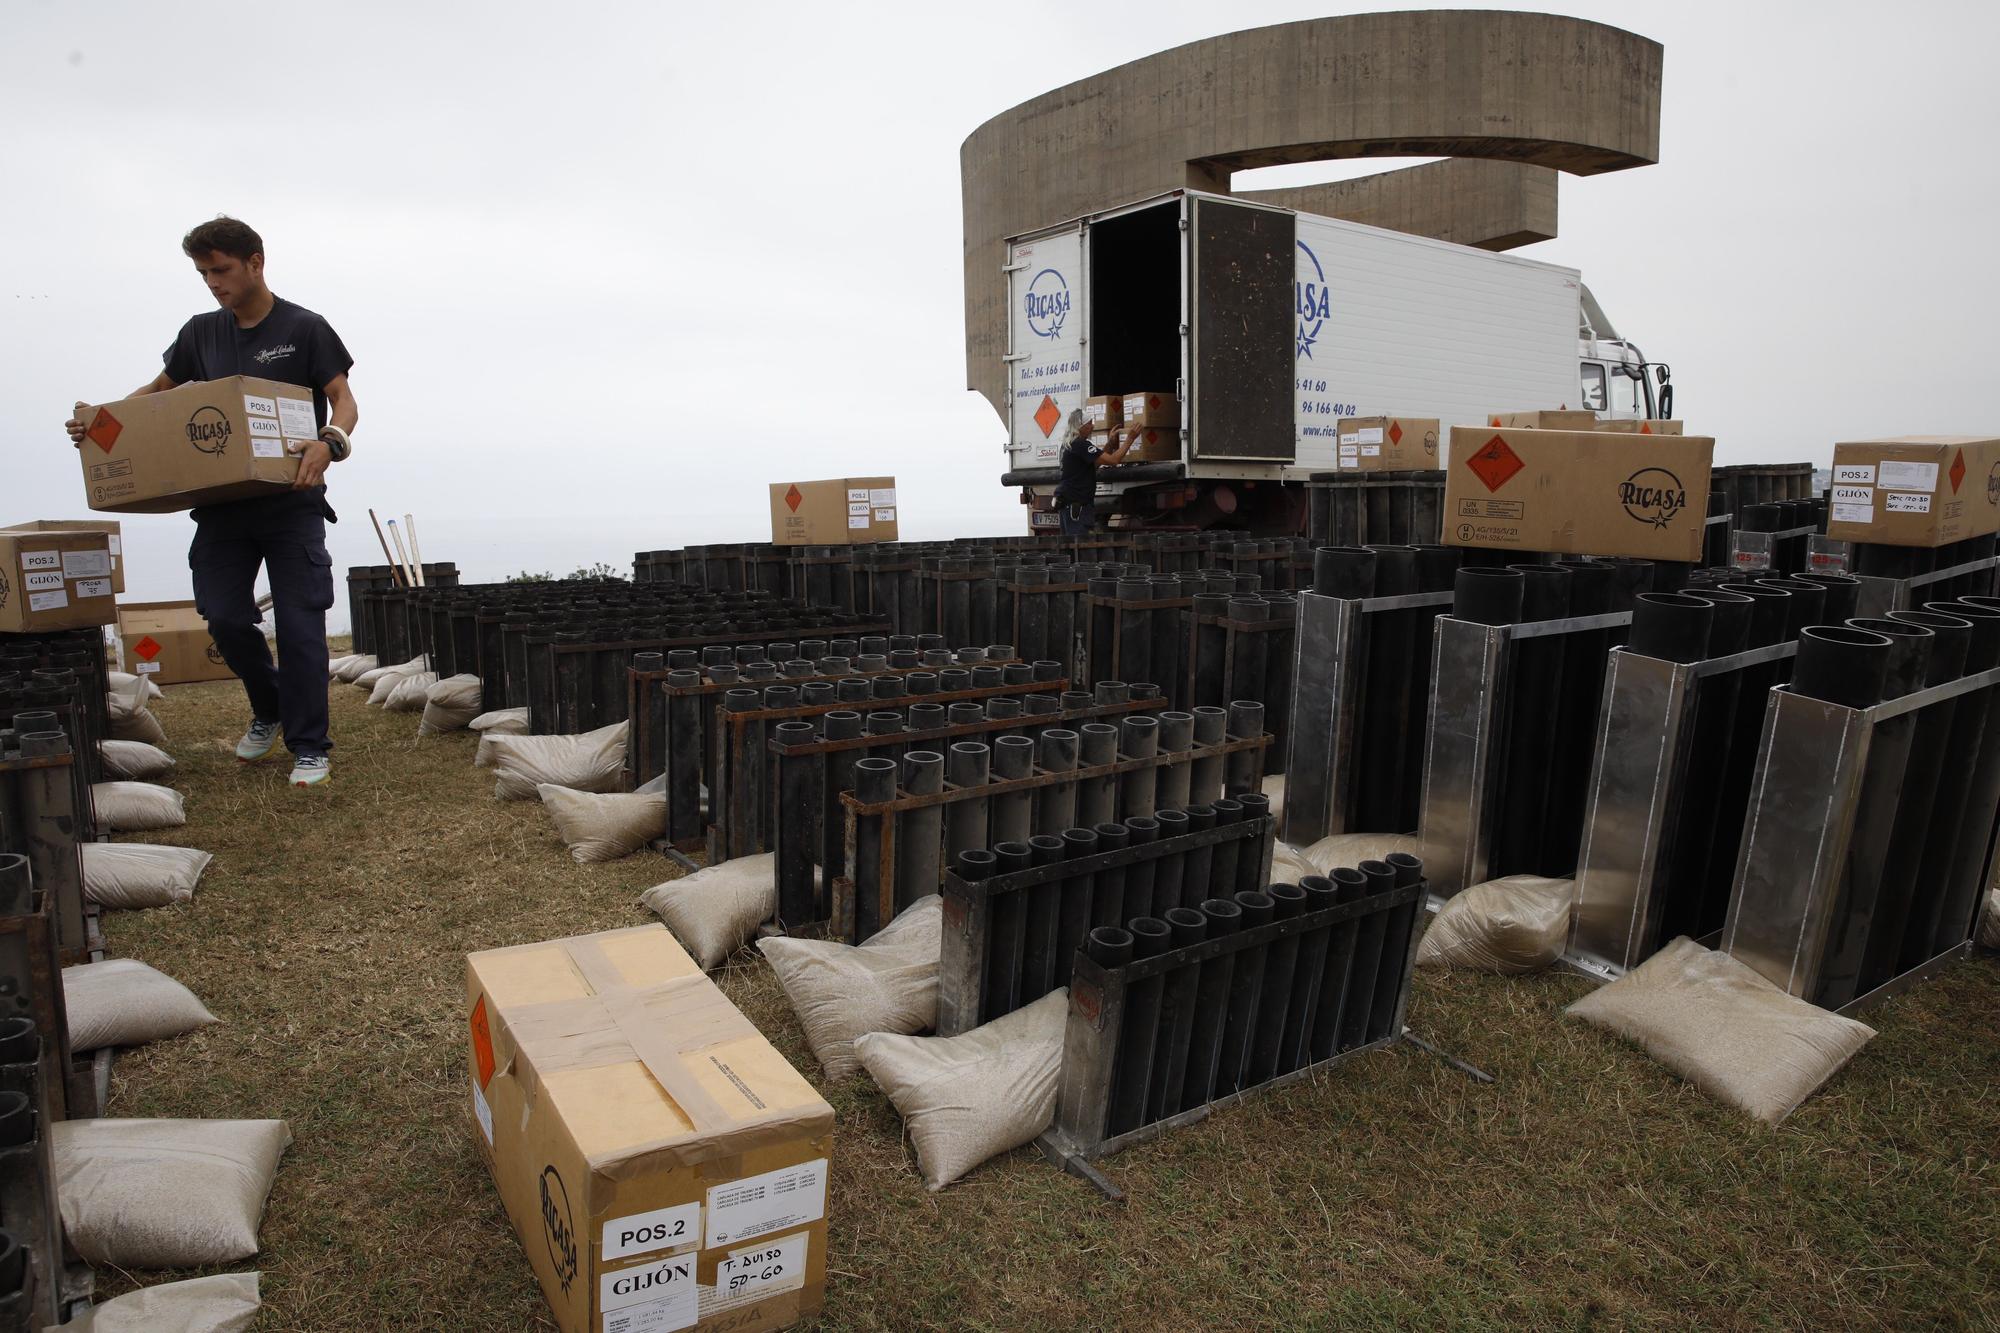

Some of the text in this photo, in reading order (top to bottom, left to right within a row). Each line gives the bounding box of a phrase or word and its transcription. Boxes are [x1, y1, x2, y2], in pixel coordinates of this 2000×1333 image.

[1025, 290, 1070, 319] RICASA
[1021, 361, 1080, 379] Tel.: 96 166 41 60
[1302, 379, 1312, 391] 41
[1315, 381, 1326, 392] 60
[250, 402, 272, 413] POS.2
[1302, 401, 1356, 416] 96 166 40 02
[186, 421, 232, 442] RICASA
[252, 421, 277, 431] GIJÓN
[1841, 471, 1869, 479] POS.2
[1618, 482, 1686, 510] RICASA
[1837, 489, 1870, 499] GIJÓN
[29, 557, 55, 565] POS.2
[30, 574, 60, 585] GIJÓN
[540, 1172, 577, 1277] RICASA
[621, 1220, 685, 1247] POS.2
[724, 1260, 737, 1273] T.
[613, 1262, 690, 1295] GIJÓN
[729, 1265, 783, 1289] 50-60
